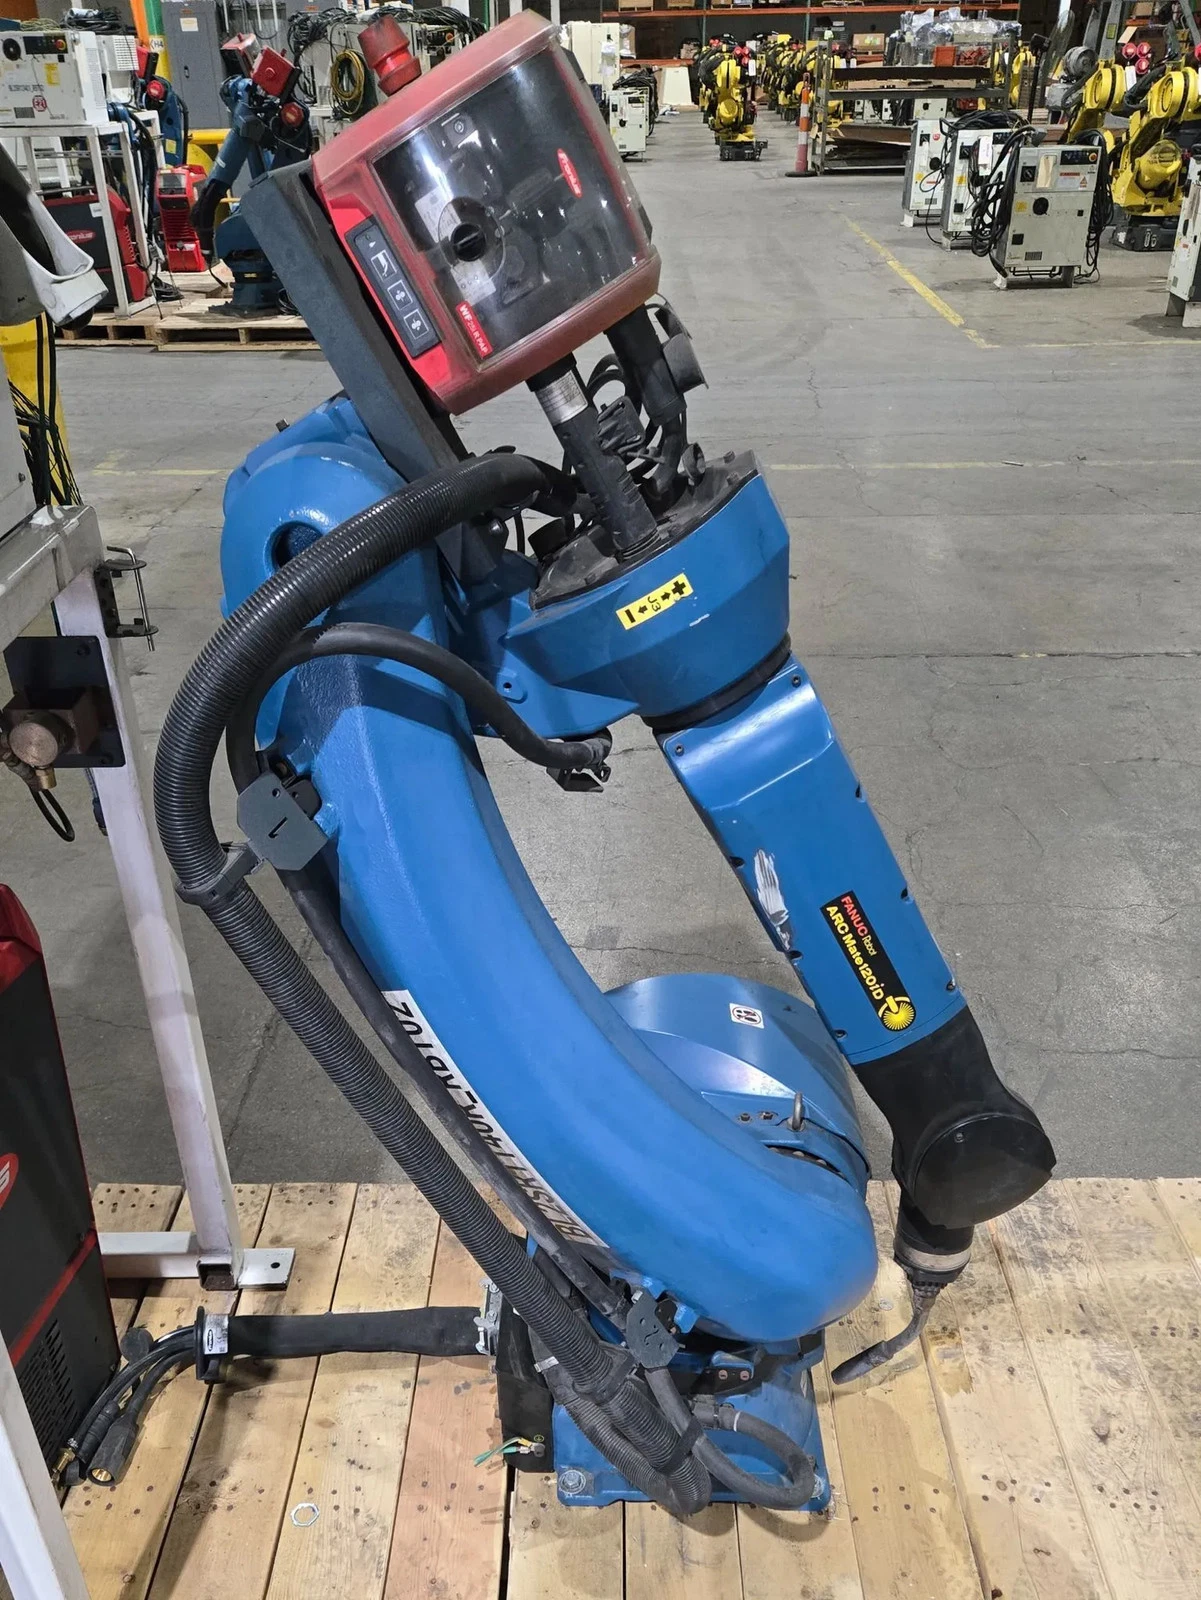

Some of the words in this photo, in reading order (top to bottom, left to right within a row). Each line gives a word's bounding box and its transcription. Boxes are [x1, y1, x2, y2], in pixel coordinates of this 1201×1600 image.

[460, 304, 472, 320] WF
[647, 596, 661, 612] J3
[826, 905, 849, 935] ARC
[841, 896, 868, 937] FANUC
[862, 935, 877, 957] Robot
